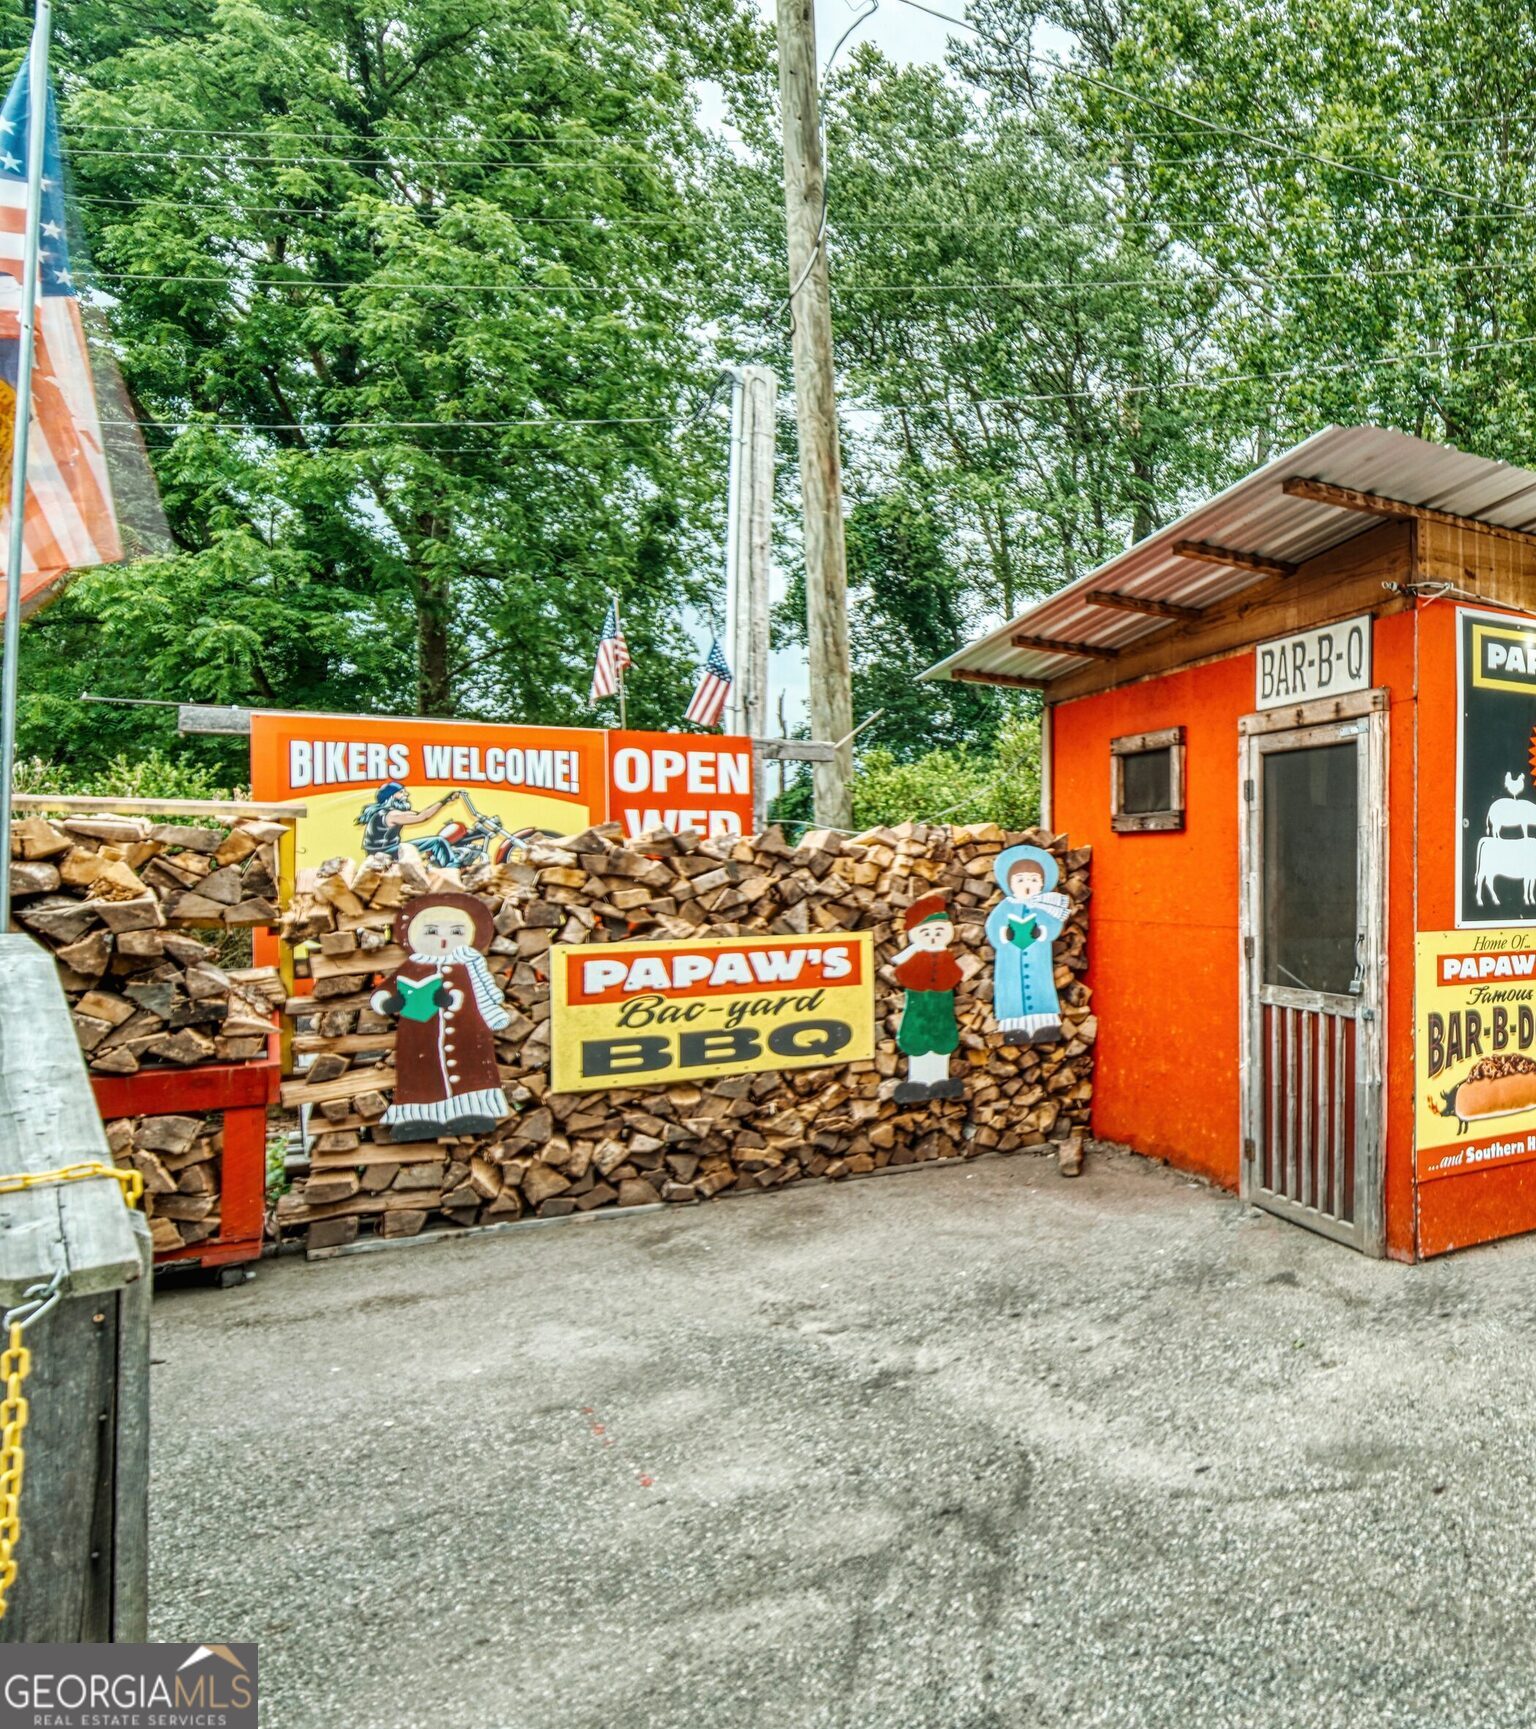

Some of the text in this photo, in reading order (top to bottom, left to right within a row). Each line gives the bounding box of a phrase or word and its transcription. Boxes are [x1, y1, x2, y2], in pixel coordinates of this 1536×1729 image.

[1261, 625, 1363, 699] BAR-B-Q
[289, 739, 580, 795] BIKERS WELCOME!
[613, 747, 751, 795] OPEN
[1473, 935, 1508, 950] Home
[583, 947, 852, 994] PAPAW'S
[617, 988, 826, 1029] Bac-yard
[1466, 986, 1534, 1005] Famous
[582, 1019, 852, 1078] BBQ
[1466, 1142, 1525, 1163] Southern
